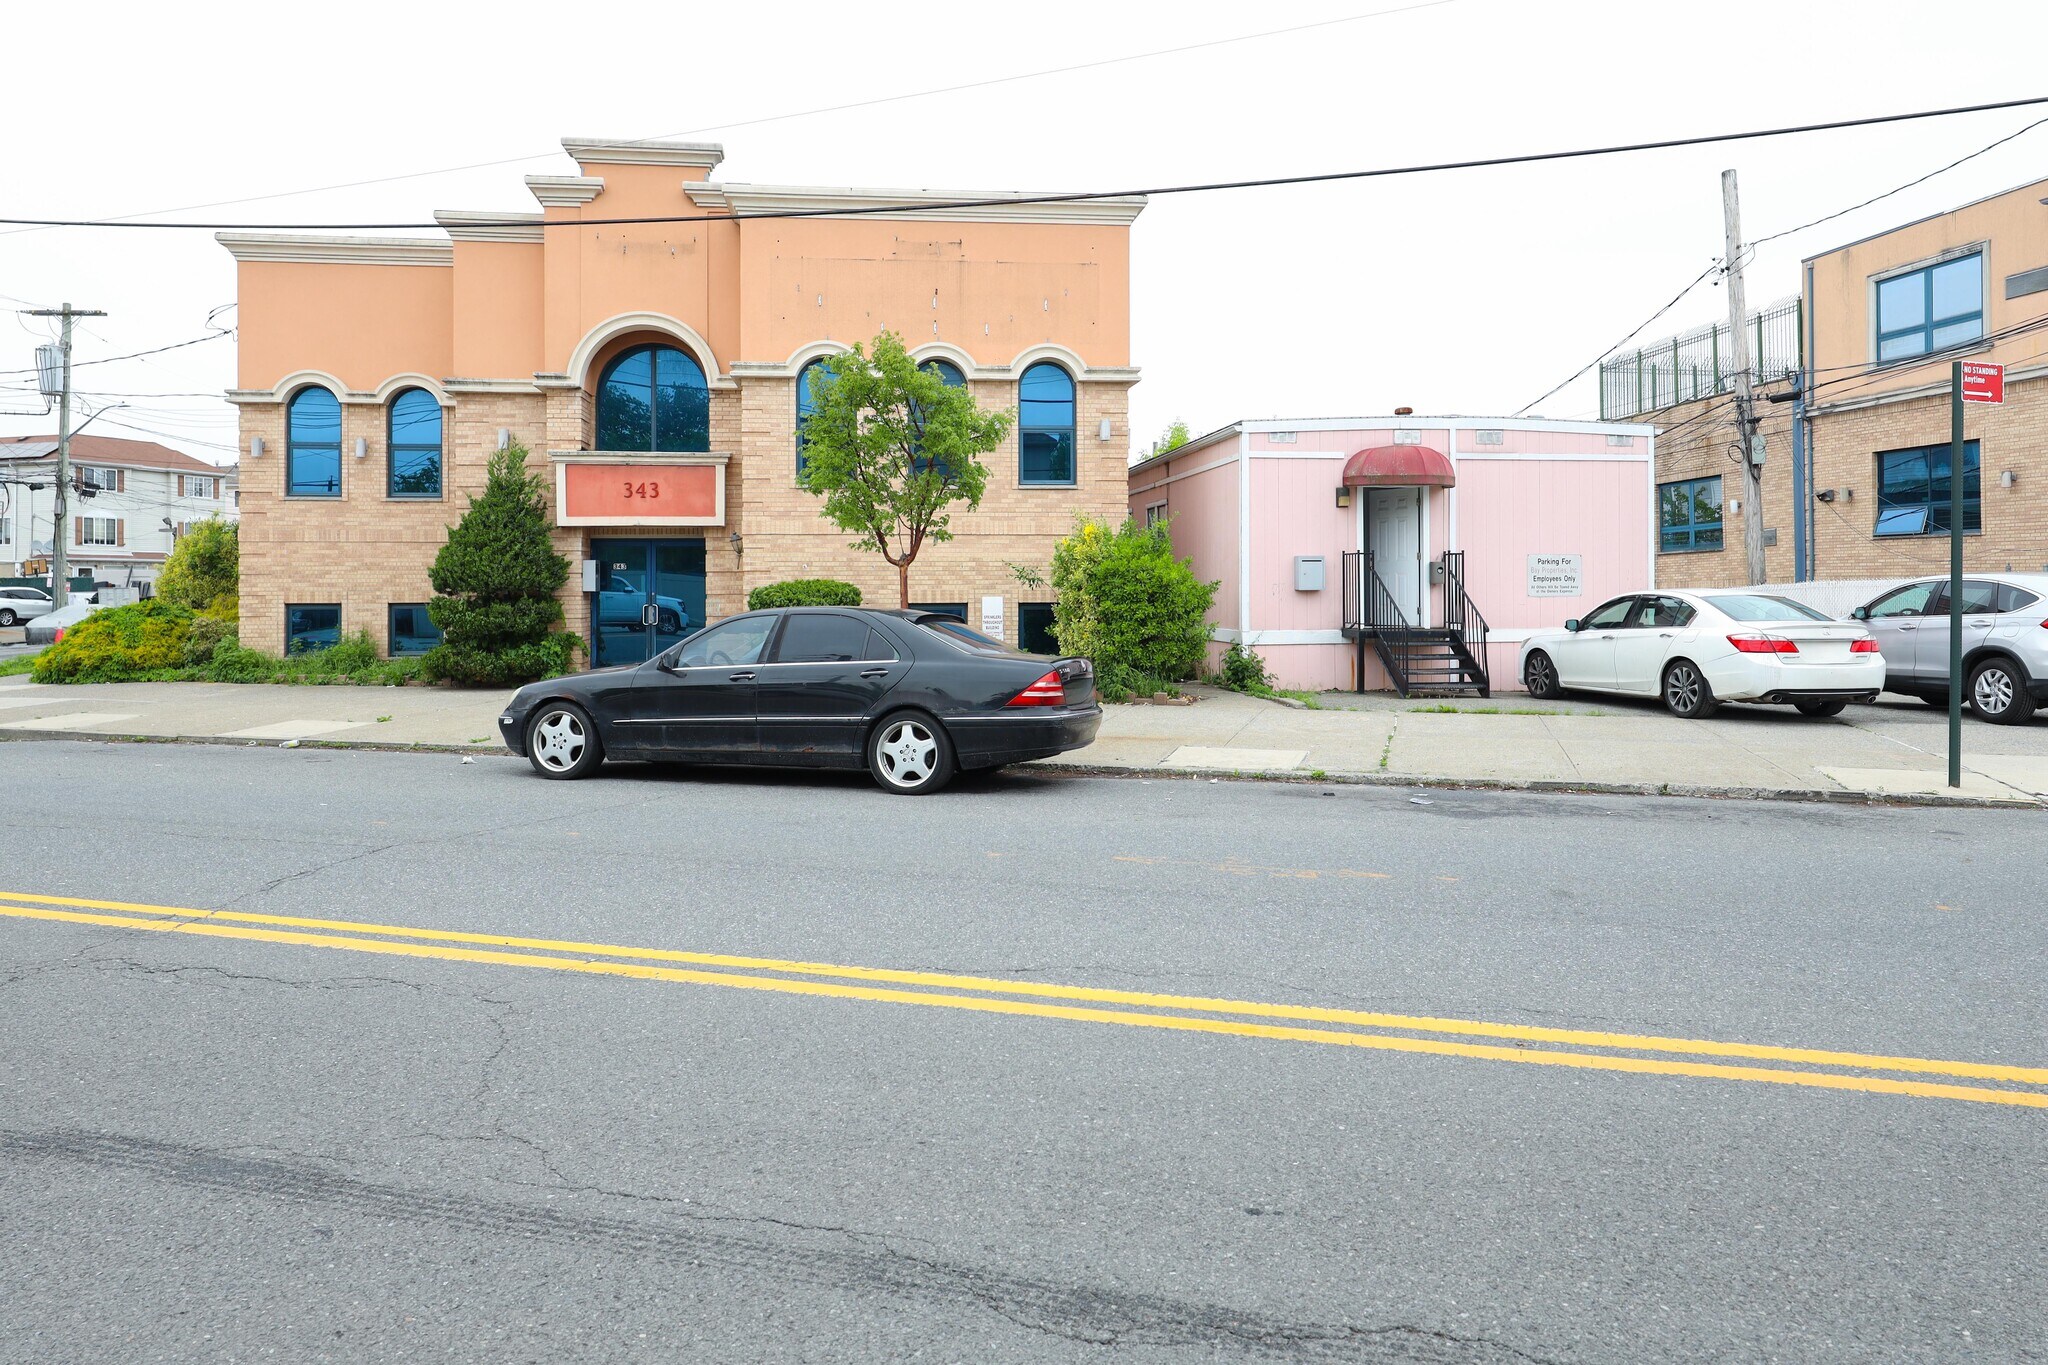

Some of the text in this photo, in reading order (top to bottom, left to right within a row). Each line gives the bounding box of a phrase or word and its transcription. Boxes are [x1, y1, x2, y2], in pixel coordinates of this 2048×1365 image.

[1973, 367, 1998, 375] STANDING
[1964, 375, 1986, 384] Anytime
[624, 482, 660, 499] 343
[1537, 558, 1560, 566] Parking
[1533, 575, 1576, 583] Employees Only
